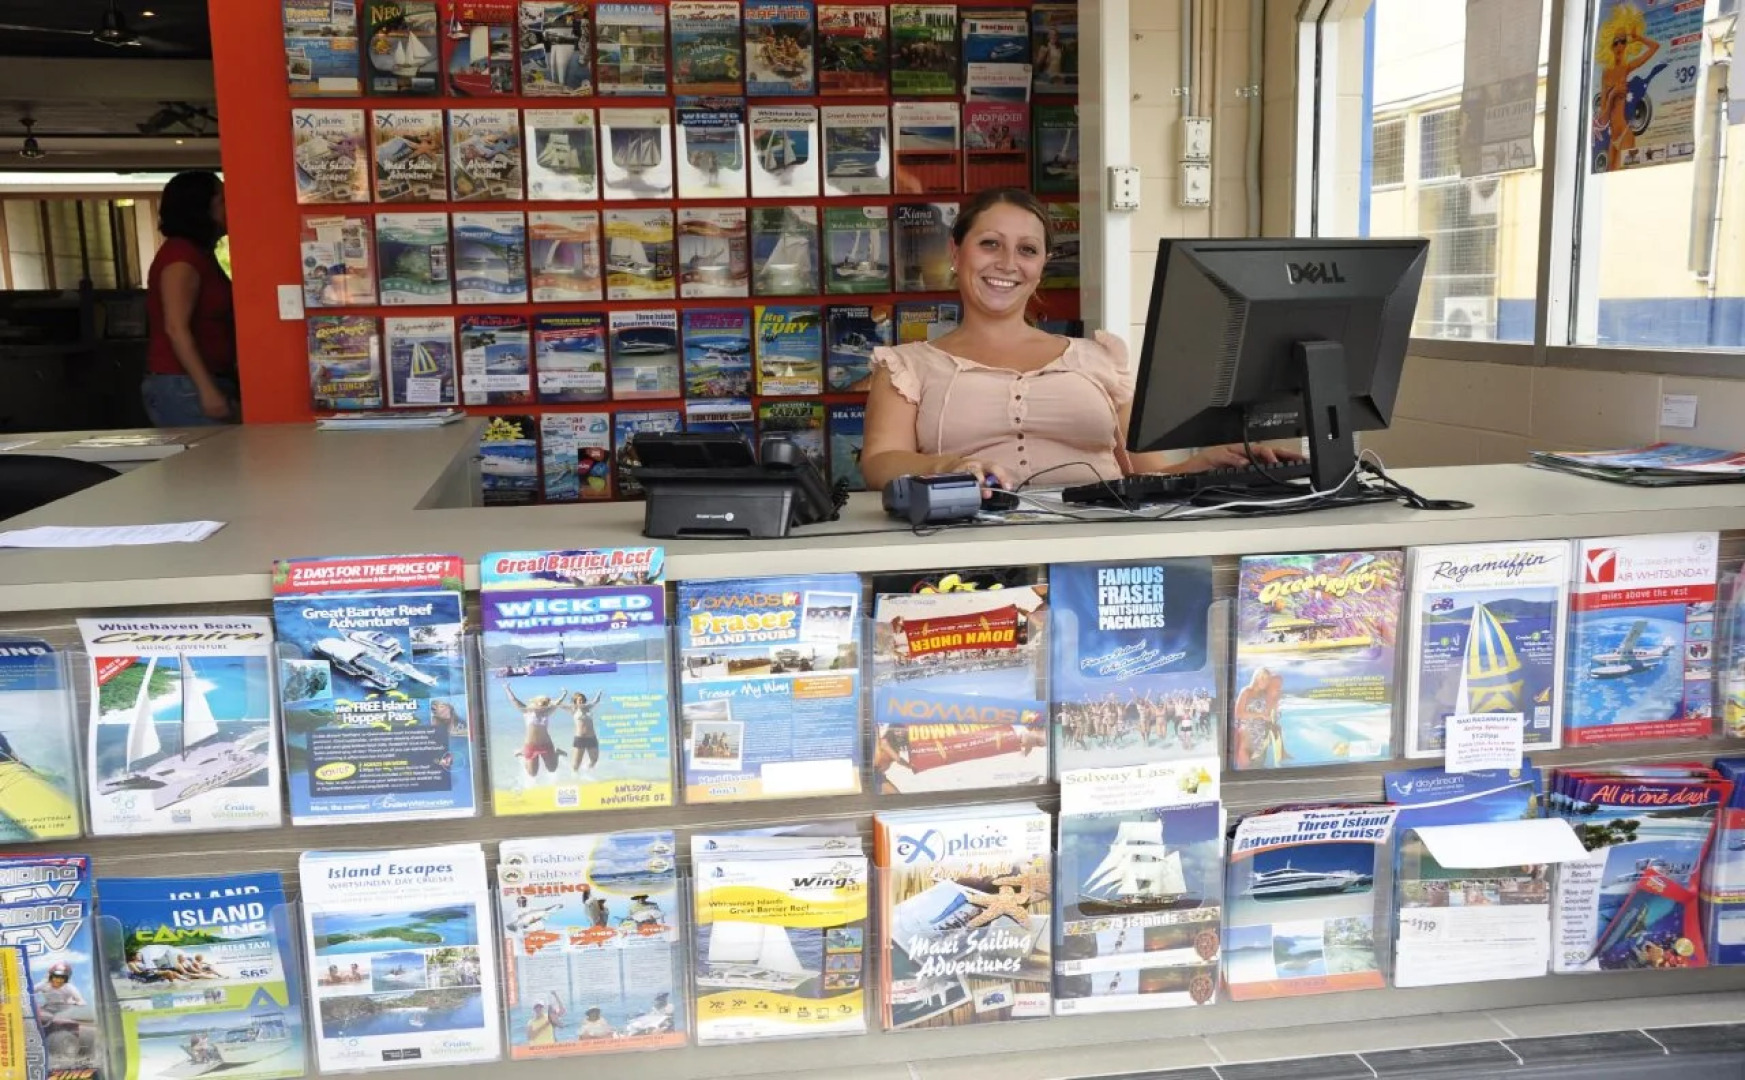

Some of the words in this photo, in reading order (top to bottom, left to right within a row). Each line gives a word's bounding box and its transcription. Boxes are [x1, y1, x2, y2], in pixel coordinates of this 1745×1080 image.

[1675, 65, 1696, 83] $39
[1287, 262, 1345, 285] DELL
[761, 321, 808, 335] FURY
[495, 556, 546, 574] Great
[547, 553, 608, 571] Barrier
[611, 547, 655, 566] Reef
[1424, 552, 1562, 582] Ragamuffin
[293, 568, 302, 579] 2
[304, 566, 334, 579] DAYS
[336, 565, 361, 577] FOR
[363, 564, 386, 576] THE
[387, 562, 425, 575] PRICE
[426, 561, 443, 572] OF
[1098, 567, 1163, 586] FAMOUS
[1618, 572, 1633, 581] AIR
[1636, 568, 1709, 579] WHITSUNDAY
[689, 592, 783, 610] NOMADS
[1099, 585, 1163, 604] FRASER
[1601, 591, 1622, 601] miles
[1625, 589, 1650, 599] above
[1653, 588, 1667, 597] the
[1671, 587, 1688, 596] rest
[302, 607, 345, 620] Great
[349, 605, 398, 617] Barrier
[399, 603, 432, 616] Reef
[495, 595, 653, 617] WICKED
[1098, 603, 1164, 617] WHITSUNDAY
[98, 622, 199, 633] Whitehaven
[204, 622, 252, 631] Beach
[328, 617, 409, 628] Adventures
[495, 611, 654, 629] WHITSUNDAYS
[688, 610, 797, 637] Fraser
[1099, 615, 1165, 631] PACKAGES
[91, 631, 265, 645] Camira
[691, 634, 745, 646] ISLAND
[749, 628, 797, 642] TOURS
[911, 634, 962, 653] UNDER
[966, 629, 1015, 644] DOWN
[356, 701, 381, 711] FREE
[382, 700, 418, 711] Island
[887, 698, 1019, 723] NOMADS
[343, 712, 386, 725] Hopper
[388, 711, 414, 722] Pass
[1065, 772, 1130, 785] Solway
[1137, 767, 1176, 779] Lass
[1416, 775, 1463, 788] daydream
[1592, 785, 1620, 802] All
[1621, 792, 1634, 804] in
[1639, 792, 1668, 804] one
[1669, 787, 1711, 806] day!
[1297, 819, 1340, 832] Three
[1342, 815, 1389, 828] Island
[897, 829, 1008, 863] eXplore
[1238, 831, 1327, 850] Adventure
[1330, 827, 1385, 840] Cruise
[327, 864, 382, 880] Island
[388, 863, 454, 878] Escapes
[328, 878, 391, 890] WHITSUNDAY
[395, 877, 413, 886] DAY
[416, 875, 454, 885] CRUISES
[503, 883, 592, 897] FISHING
[791, 876, 856, 889] Wings
[172, 903, 264, 927] ISLAND
[1411, 919, 1436, 932] $119
[908, 932, 960, 958] Maxi
[966, 929, 1032, 954] Sailing
[915, 956, 1021, 979] Adventures
